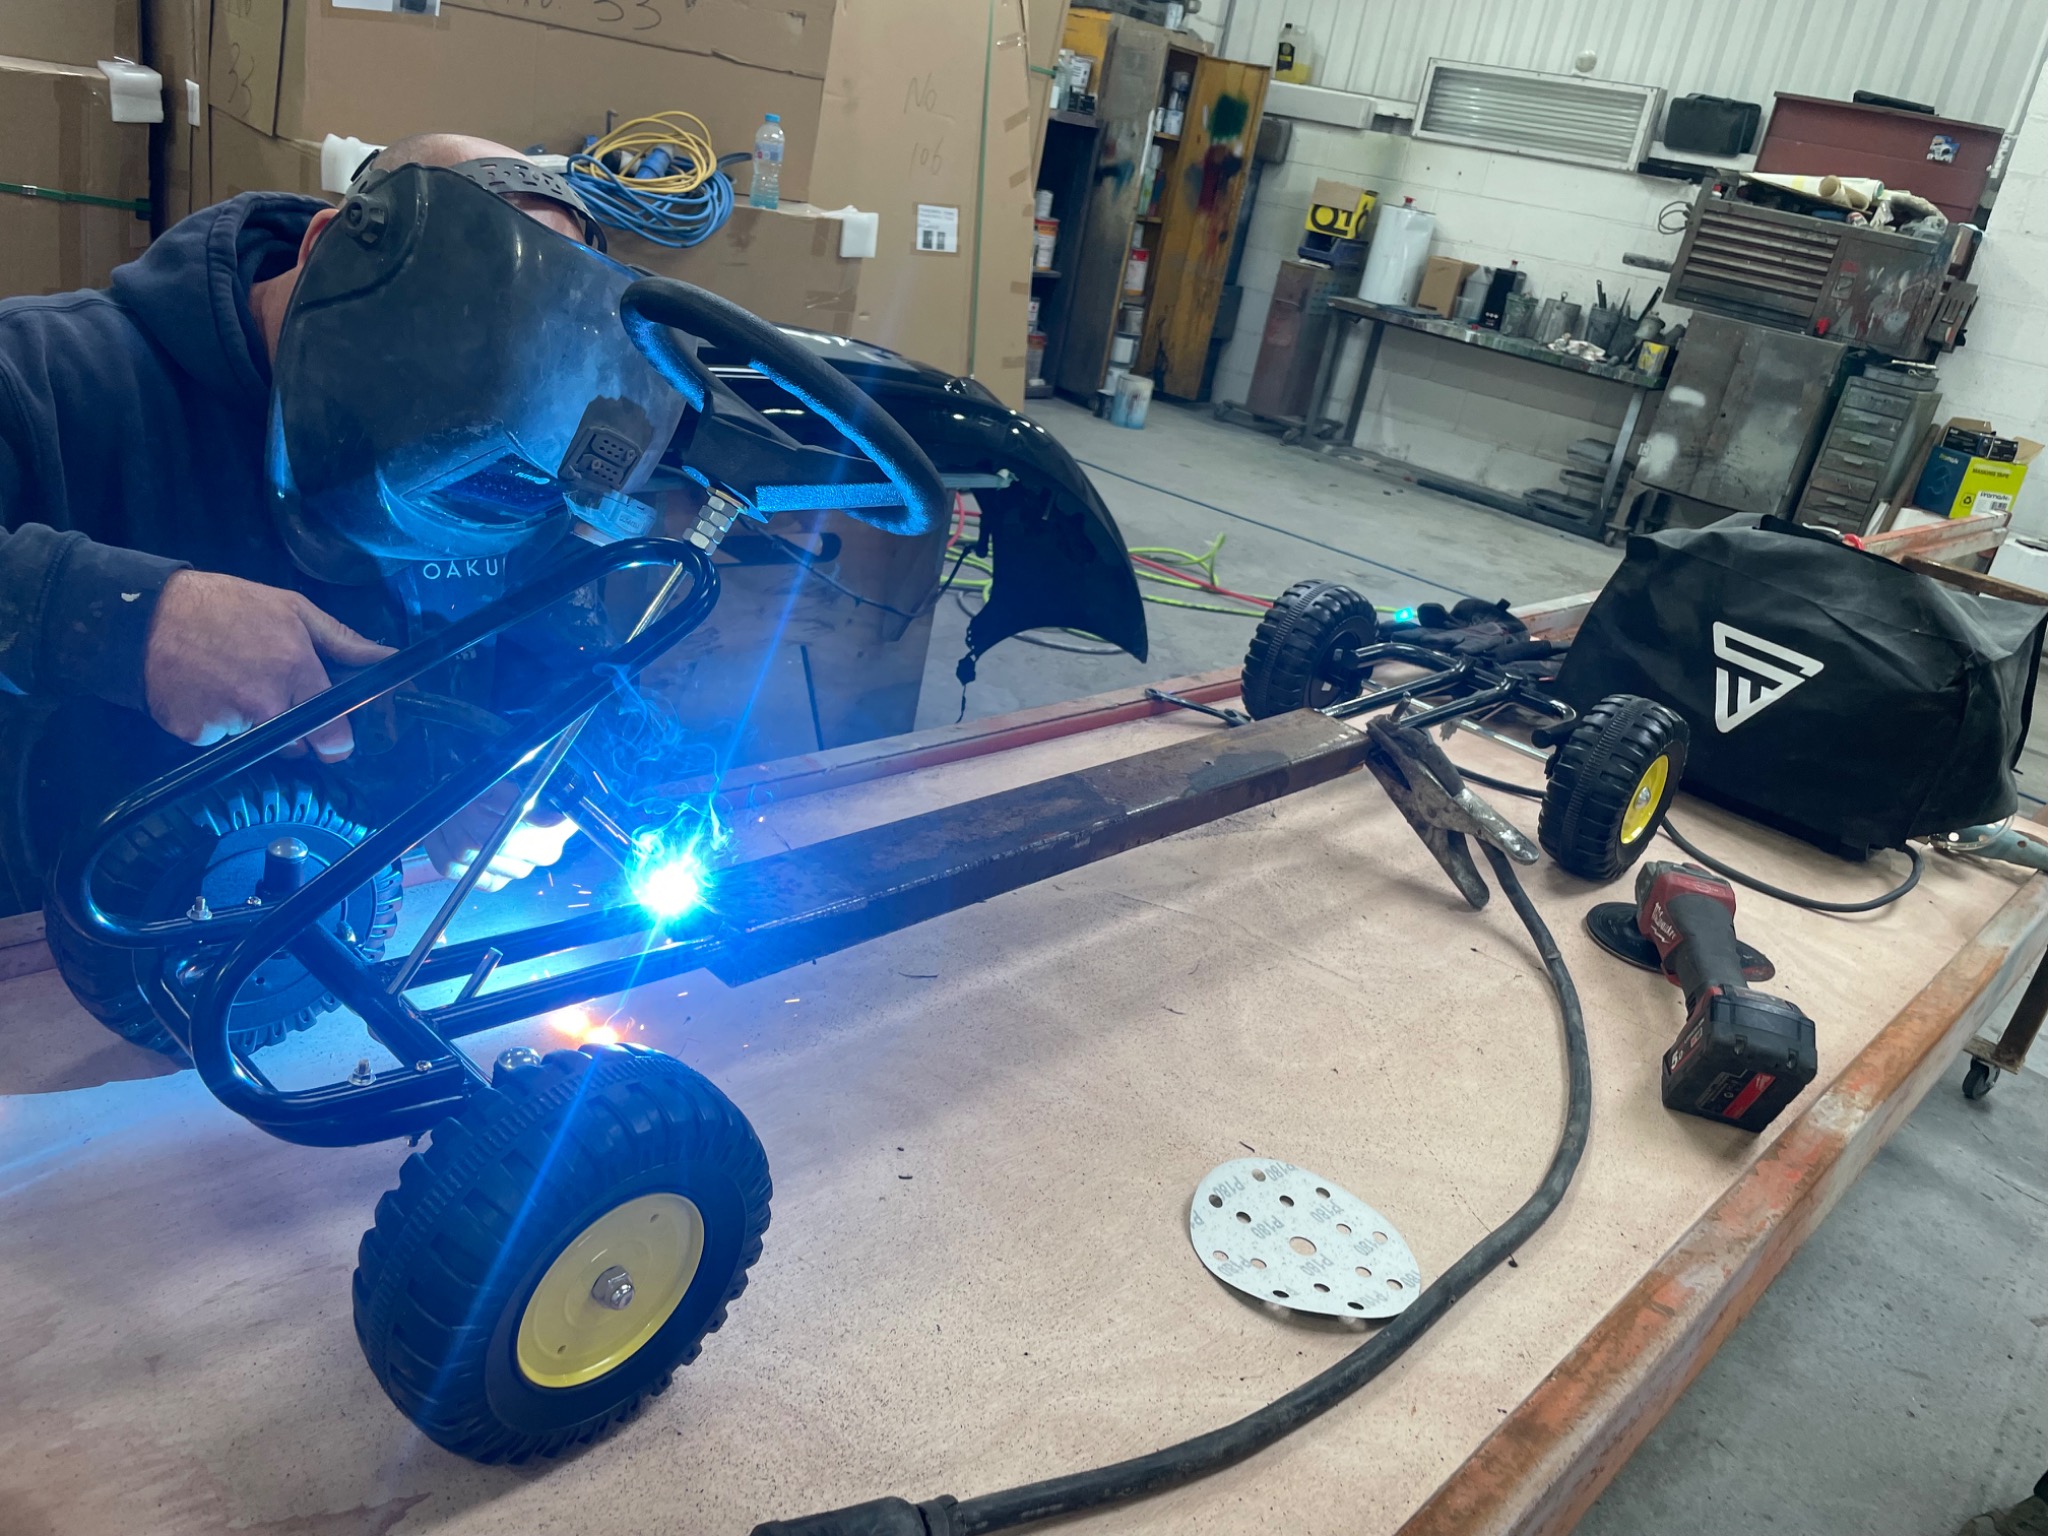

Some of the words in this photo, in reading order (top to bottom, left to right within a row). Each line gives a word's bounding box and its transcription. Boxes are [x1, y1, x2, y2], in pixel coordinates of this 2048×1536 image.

[423, 556, 506, 580] OAKU
[1310, 1200, 1345, 1223] P180
[1250, 1215, 1285, 1240] P180
[1299, 1254, 1335, 1277] P180
